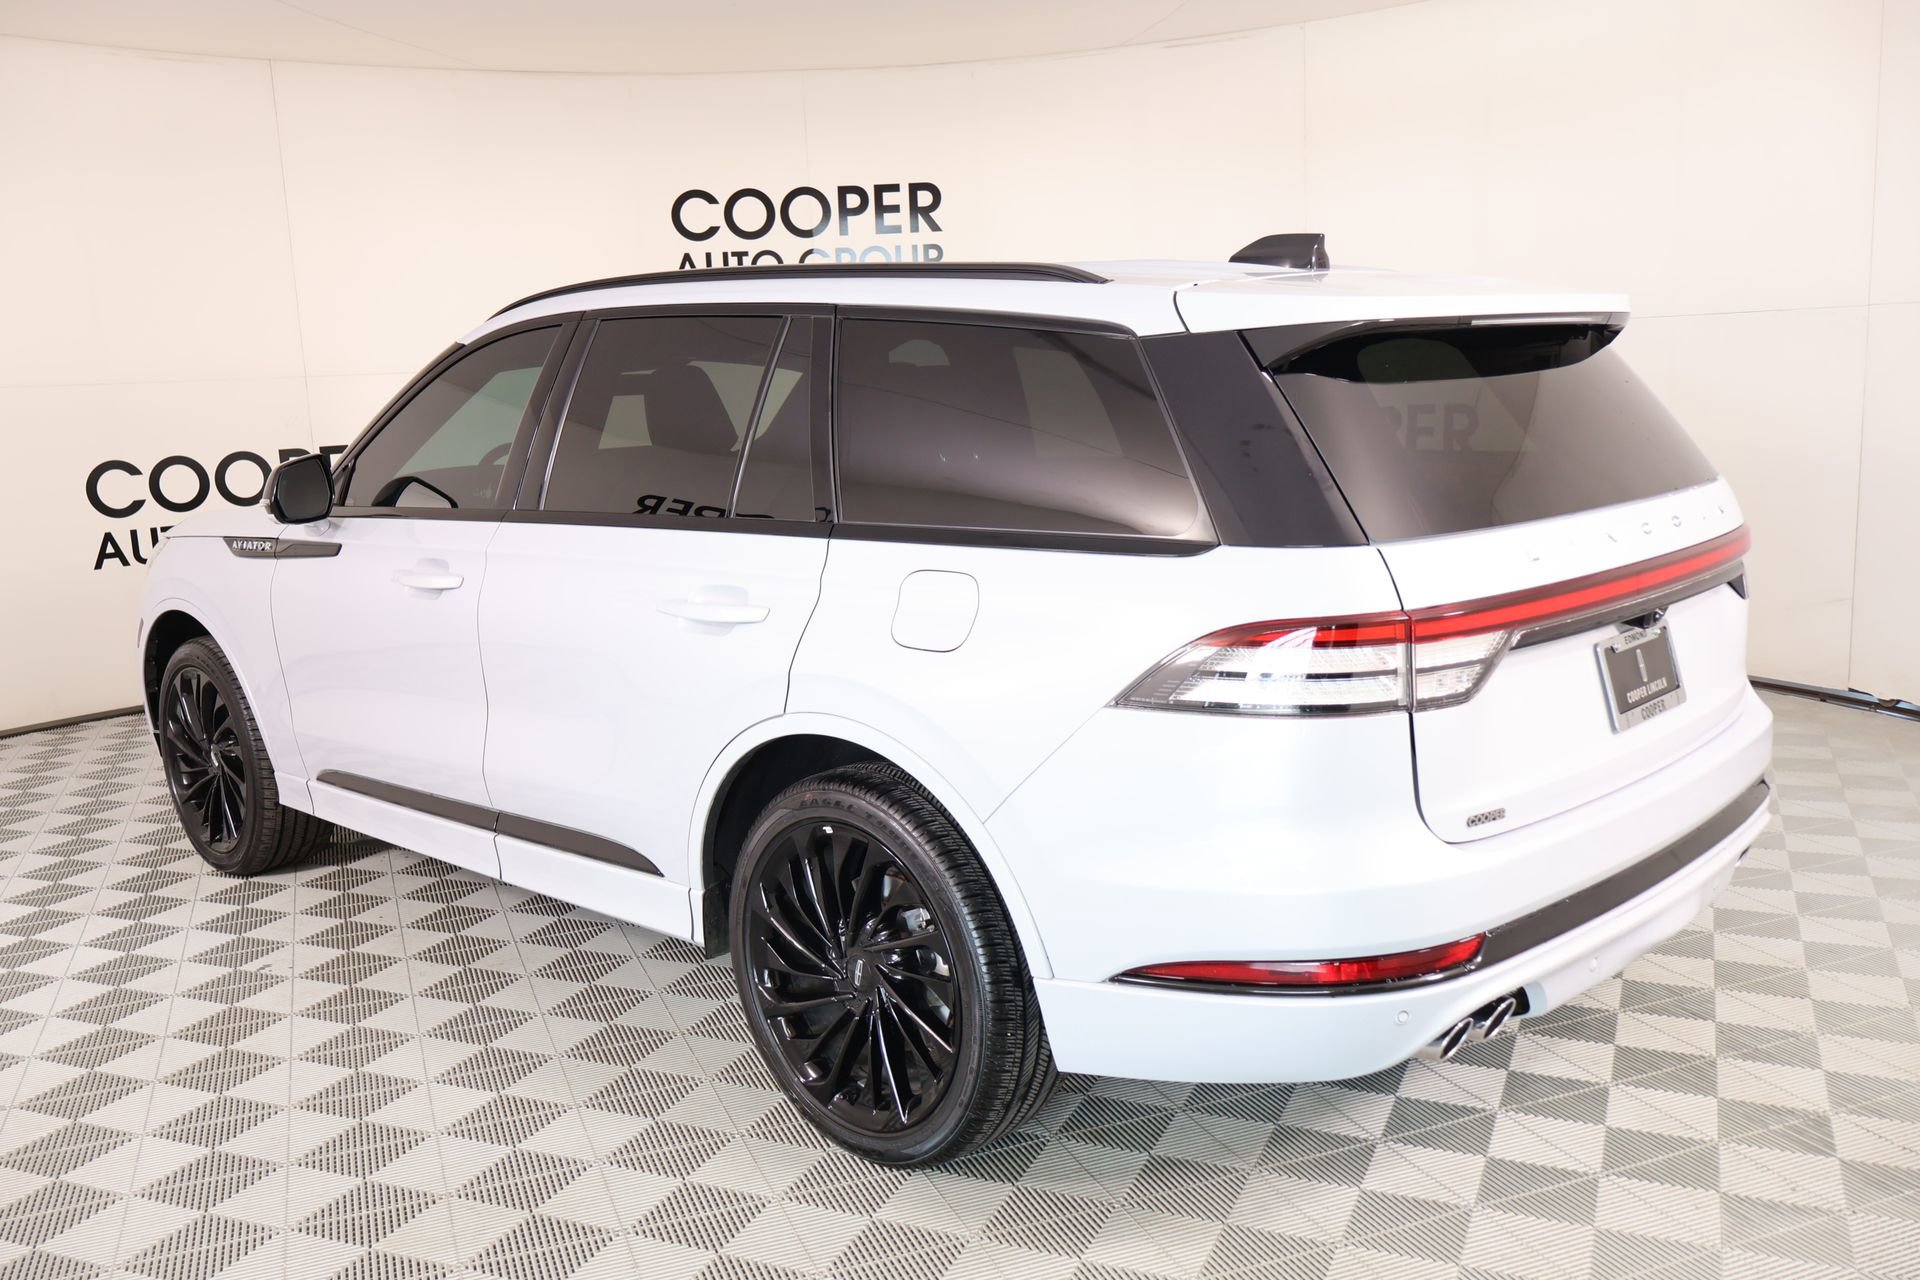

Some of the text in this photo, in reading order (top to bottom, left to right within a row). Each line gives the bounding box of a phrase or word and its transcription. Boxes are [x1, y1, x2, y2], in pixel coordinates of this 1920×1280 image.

[671, 182, 943, 242] COOPER
[86, 444, 349, 518] COO
[94, 525, 175, 570] AU
[232, 540, 272, 551] AVIATOR
[1626, 686, 1648, 703] COOPER
[1640, 699, 1666, 720] COOPER
